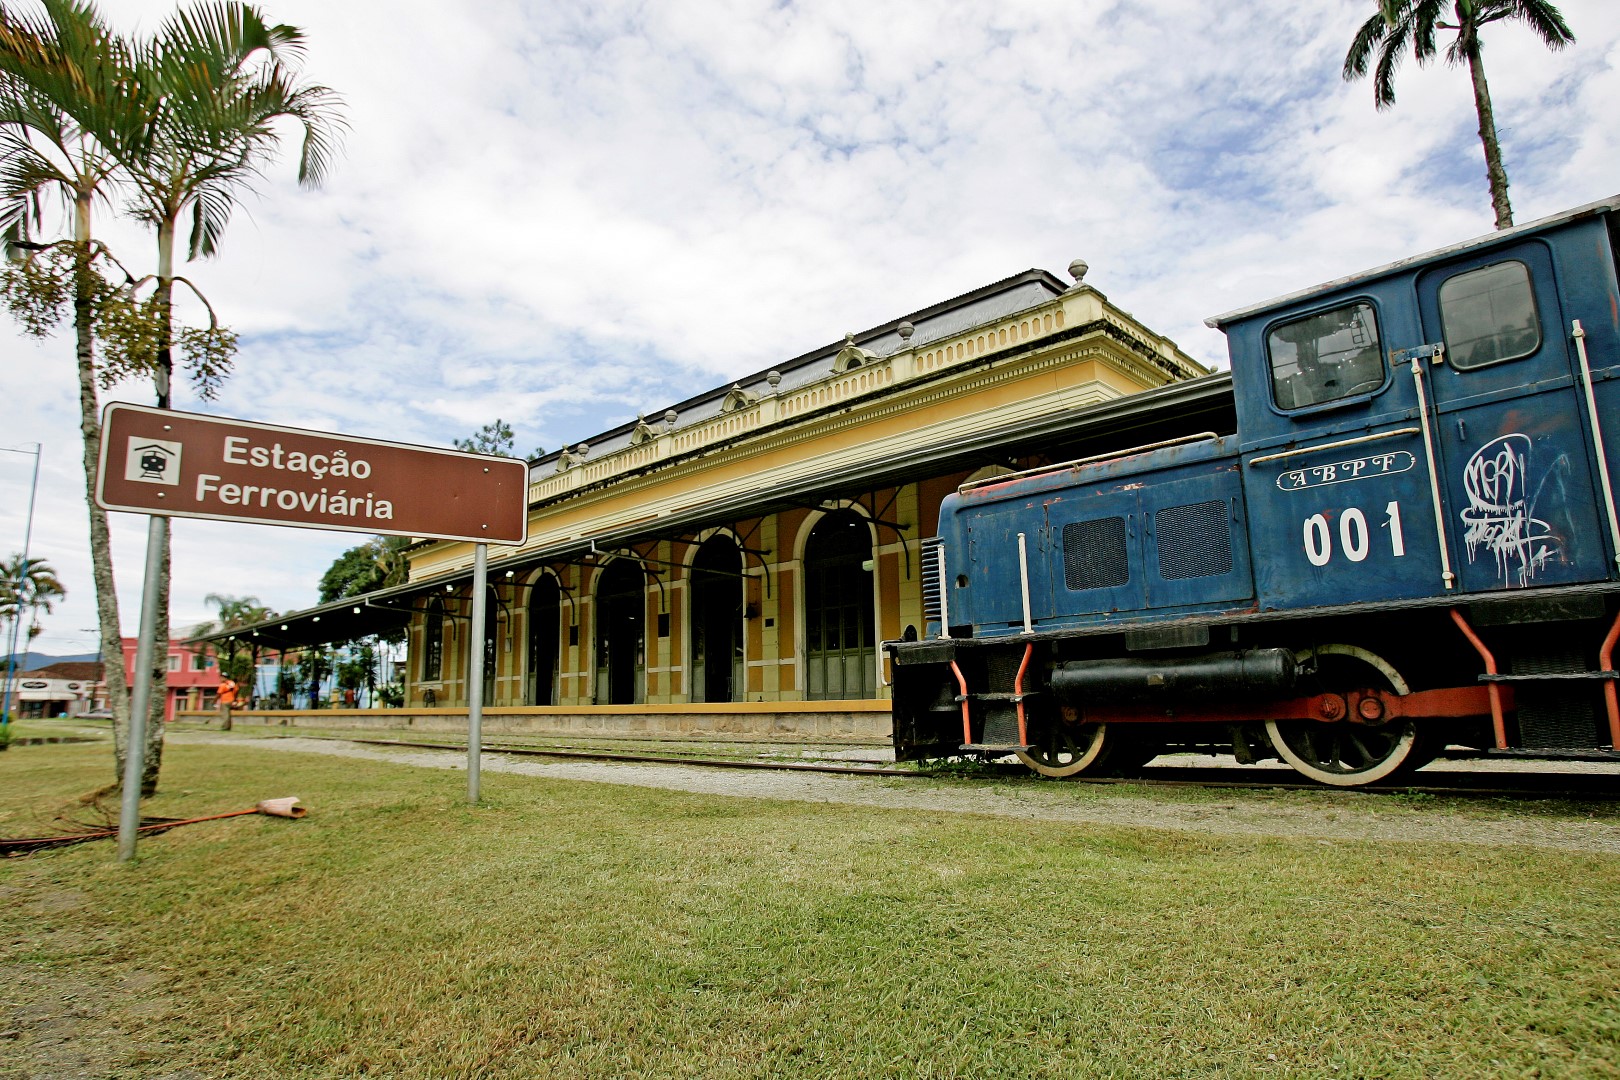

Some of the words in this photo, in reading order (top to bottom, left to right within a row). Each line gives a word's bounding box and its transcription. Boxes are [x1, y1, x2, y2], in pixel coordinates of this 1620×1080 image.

[223, 436, 372, 480] Estação
[195, 473, 394, 520] Ferroviária
[1303, 501, 1405, 567] 001
